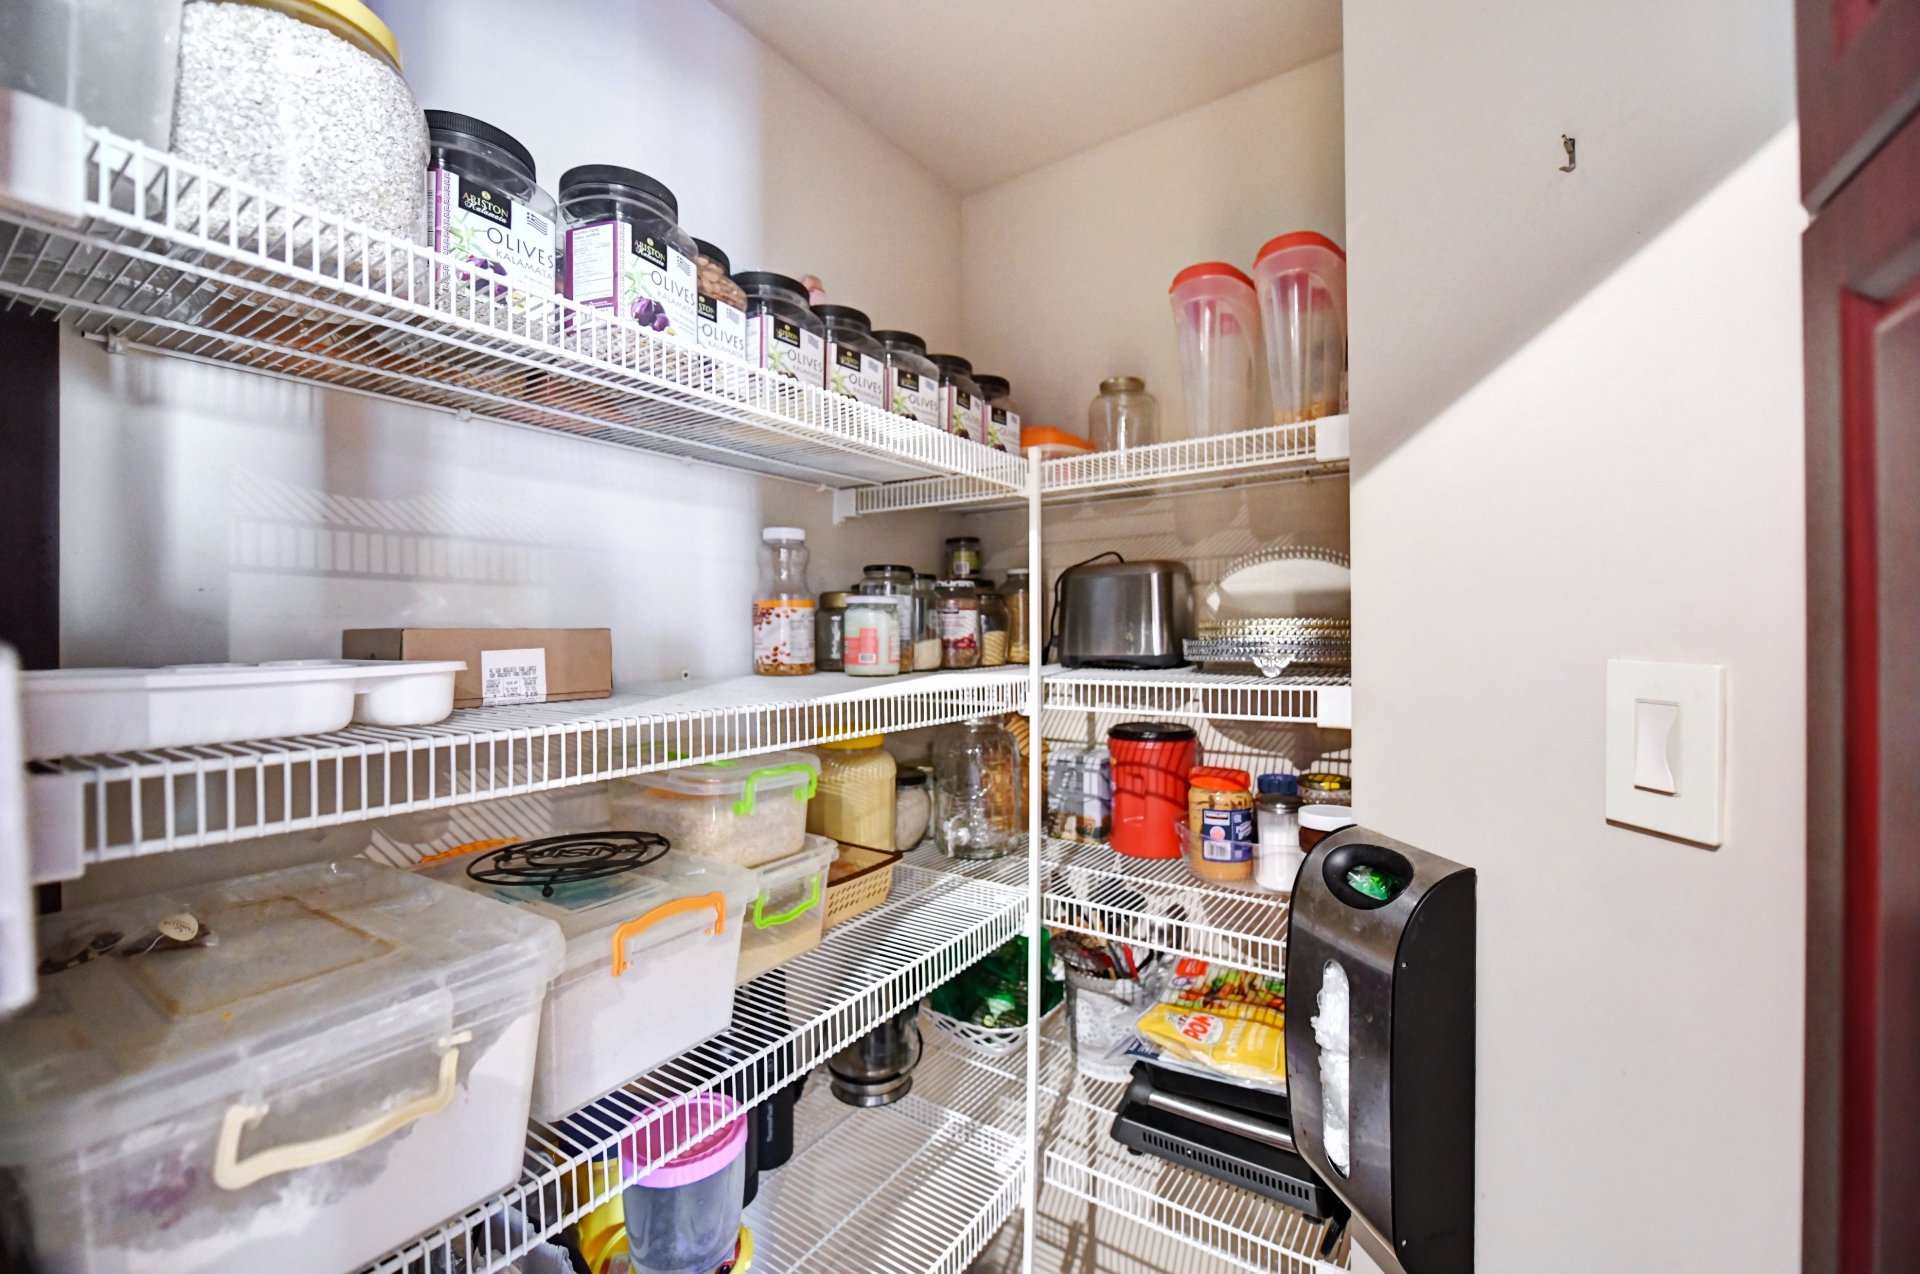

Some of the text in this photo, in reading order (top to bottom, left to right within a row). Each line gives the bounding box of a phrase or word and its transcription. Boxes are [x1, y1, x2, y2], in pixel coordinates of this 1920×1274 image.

[462, 192, 508, 218] ARISTON
[464, 200, 508, 223] Kalamata
[487, 227, 554, 269] OLIVES
[634, 239, 666, 262] ARISTON
[496, 248, 553, 280] KALAMATA
[651, 270, 695, 307] OLIVES
[657, 290, 695, 316] KALAMATA
[702, 323, 744, 351] OLIVES
[787, 348, 823, 373] OLIVES
[848, 373, 882, 394] OLIVES
[908, 393, 938, 411] OLIVES
